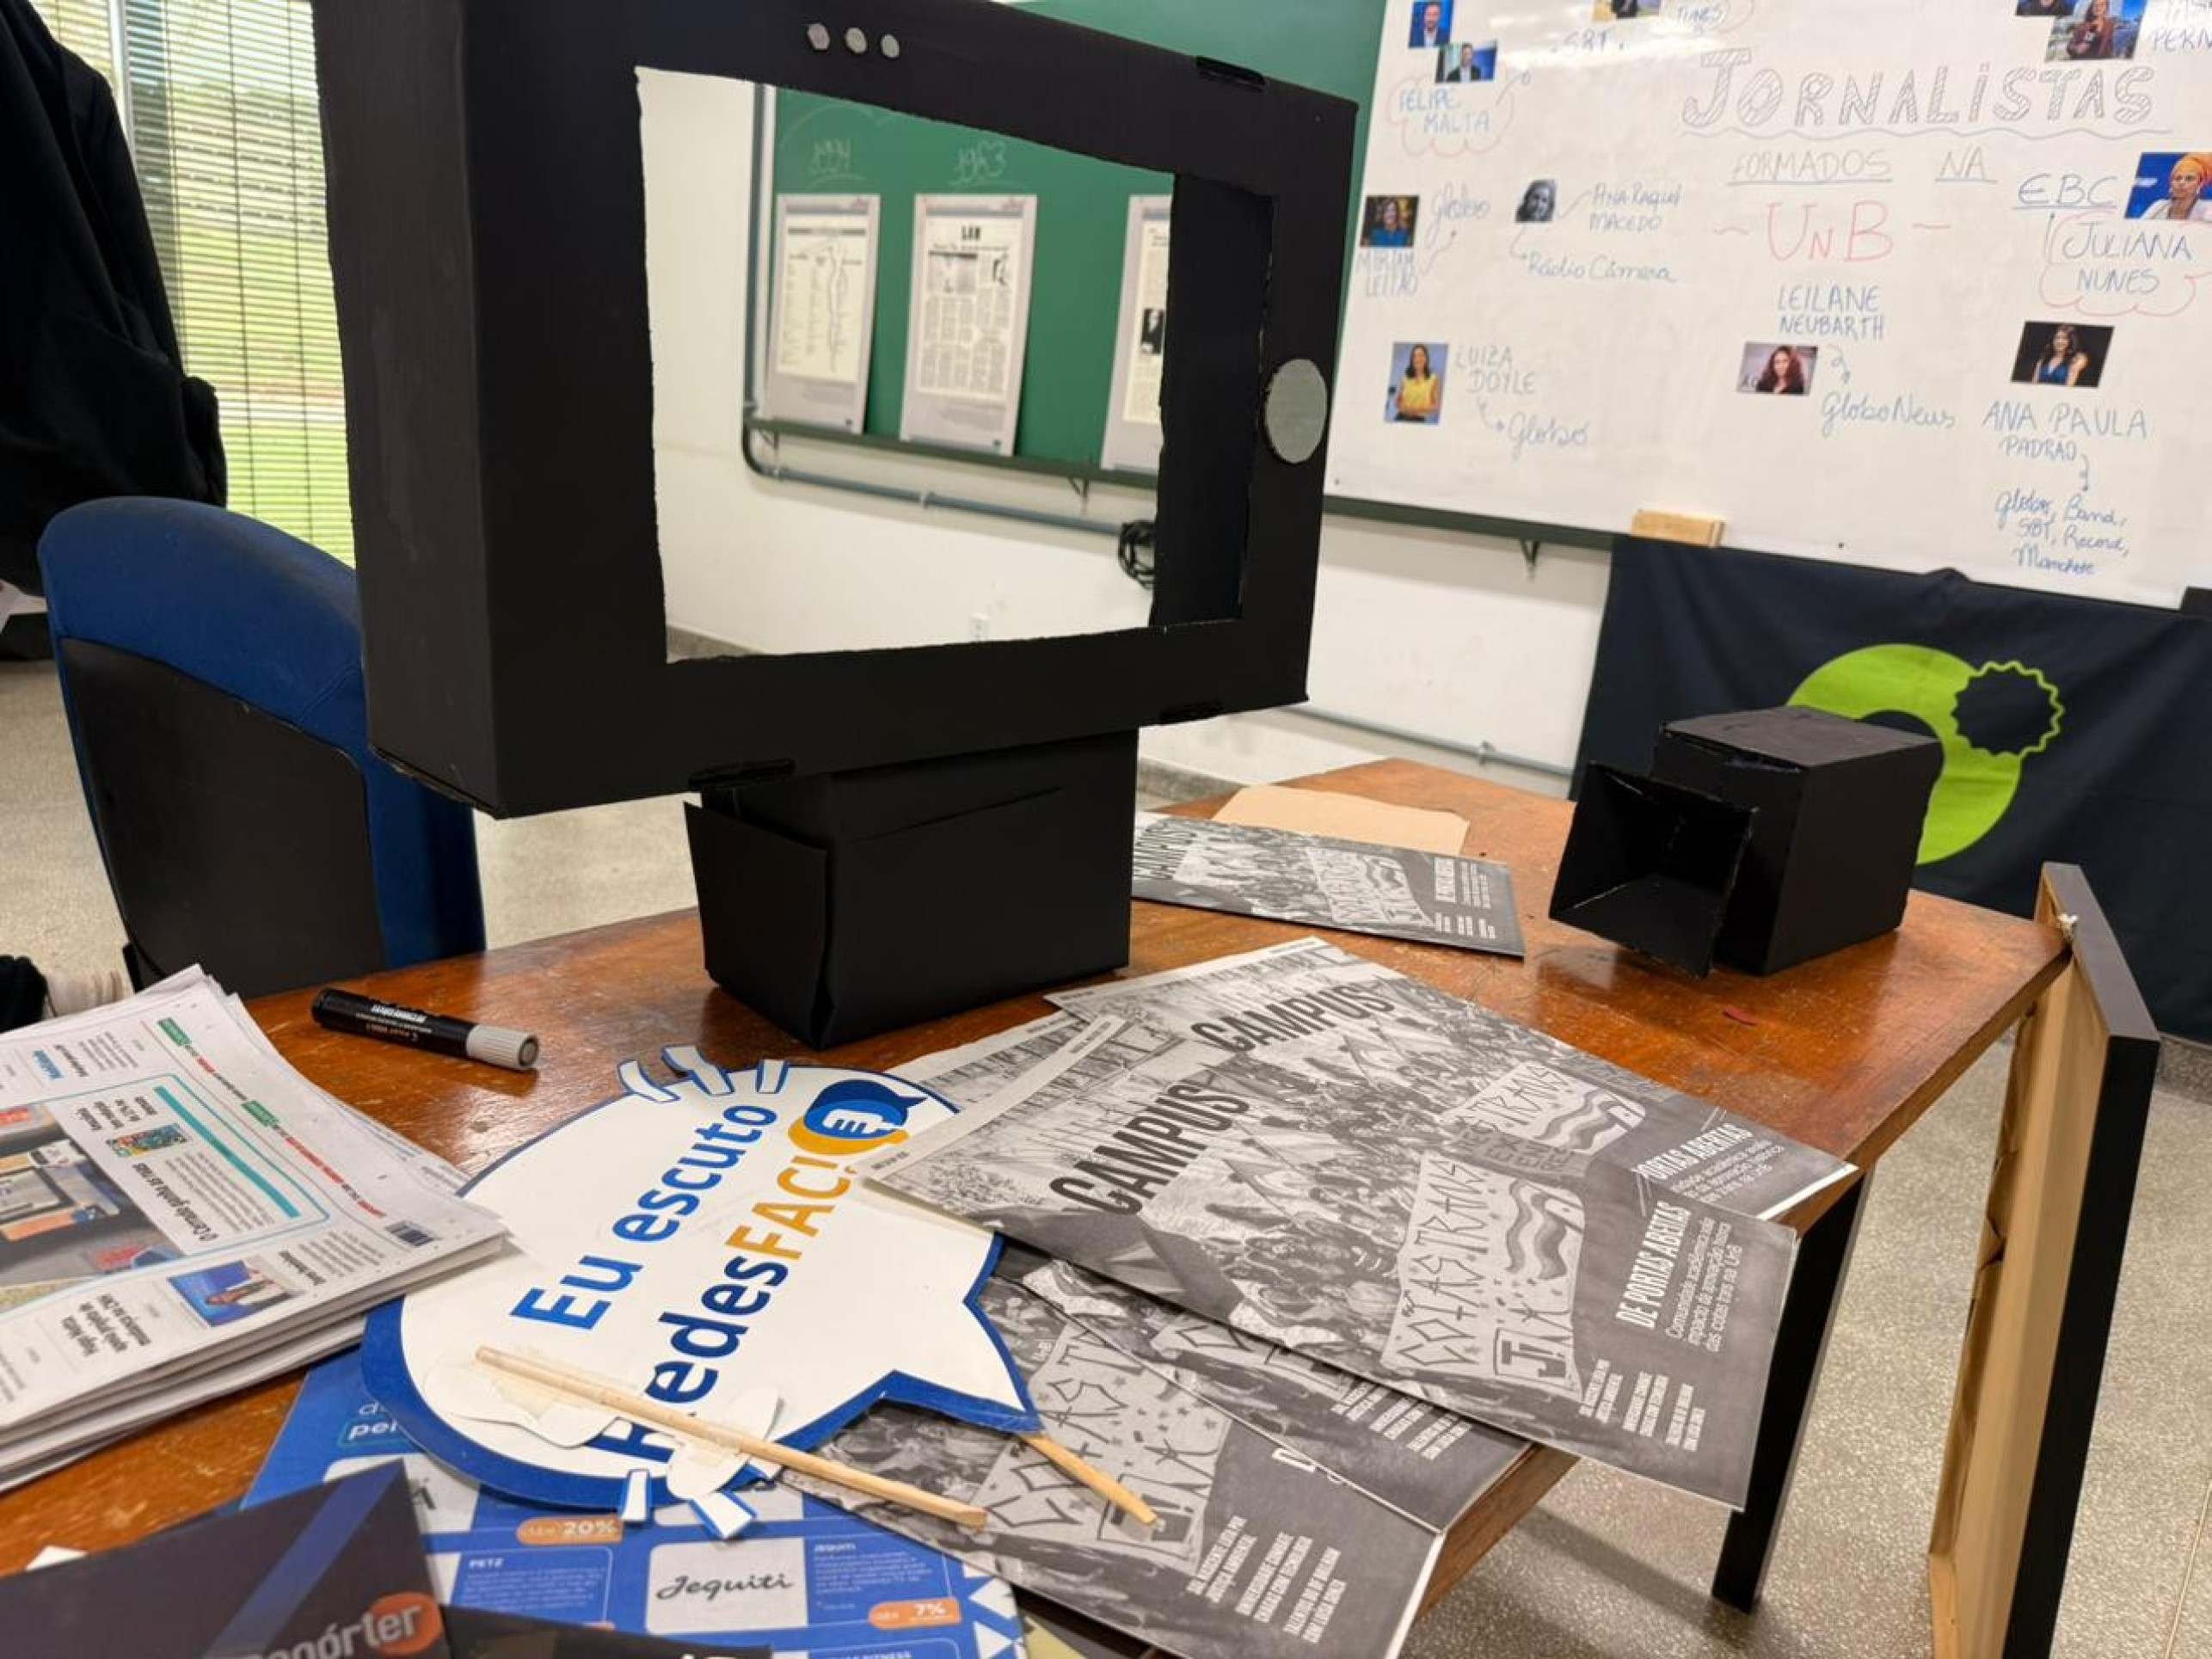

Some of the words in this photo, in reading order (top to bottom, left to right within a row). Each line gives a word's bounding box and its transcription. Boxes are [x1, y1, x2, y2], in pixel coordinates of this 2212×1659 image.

[1683, 46, 2155, 126] JORNALISTAS
[1939, 146, 1988, 181] NA
[2018, 174, 2117, 206] EBC
[2061, 220, 2193, 261] JULIANA
[1779, 285, 1881, 312] LEILANE
[2076, 268, 2161, 294] NUNES
[1465, 371, 1535, 394] DOYLE
[1983, 400, 2037, 430] ANA
[2050, 402, 2147, 439] PAULA
[1191, 983, 1395, 1053] CAMPUS
[1049, 1079, 1250, 1216] CAMPUS
[509, 1254, 643, 1330] Eu
[612, 1104, 778, 1243] escuto
[656, 1574, 793, 1601] Jequiti
